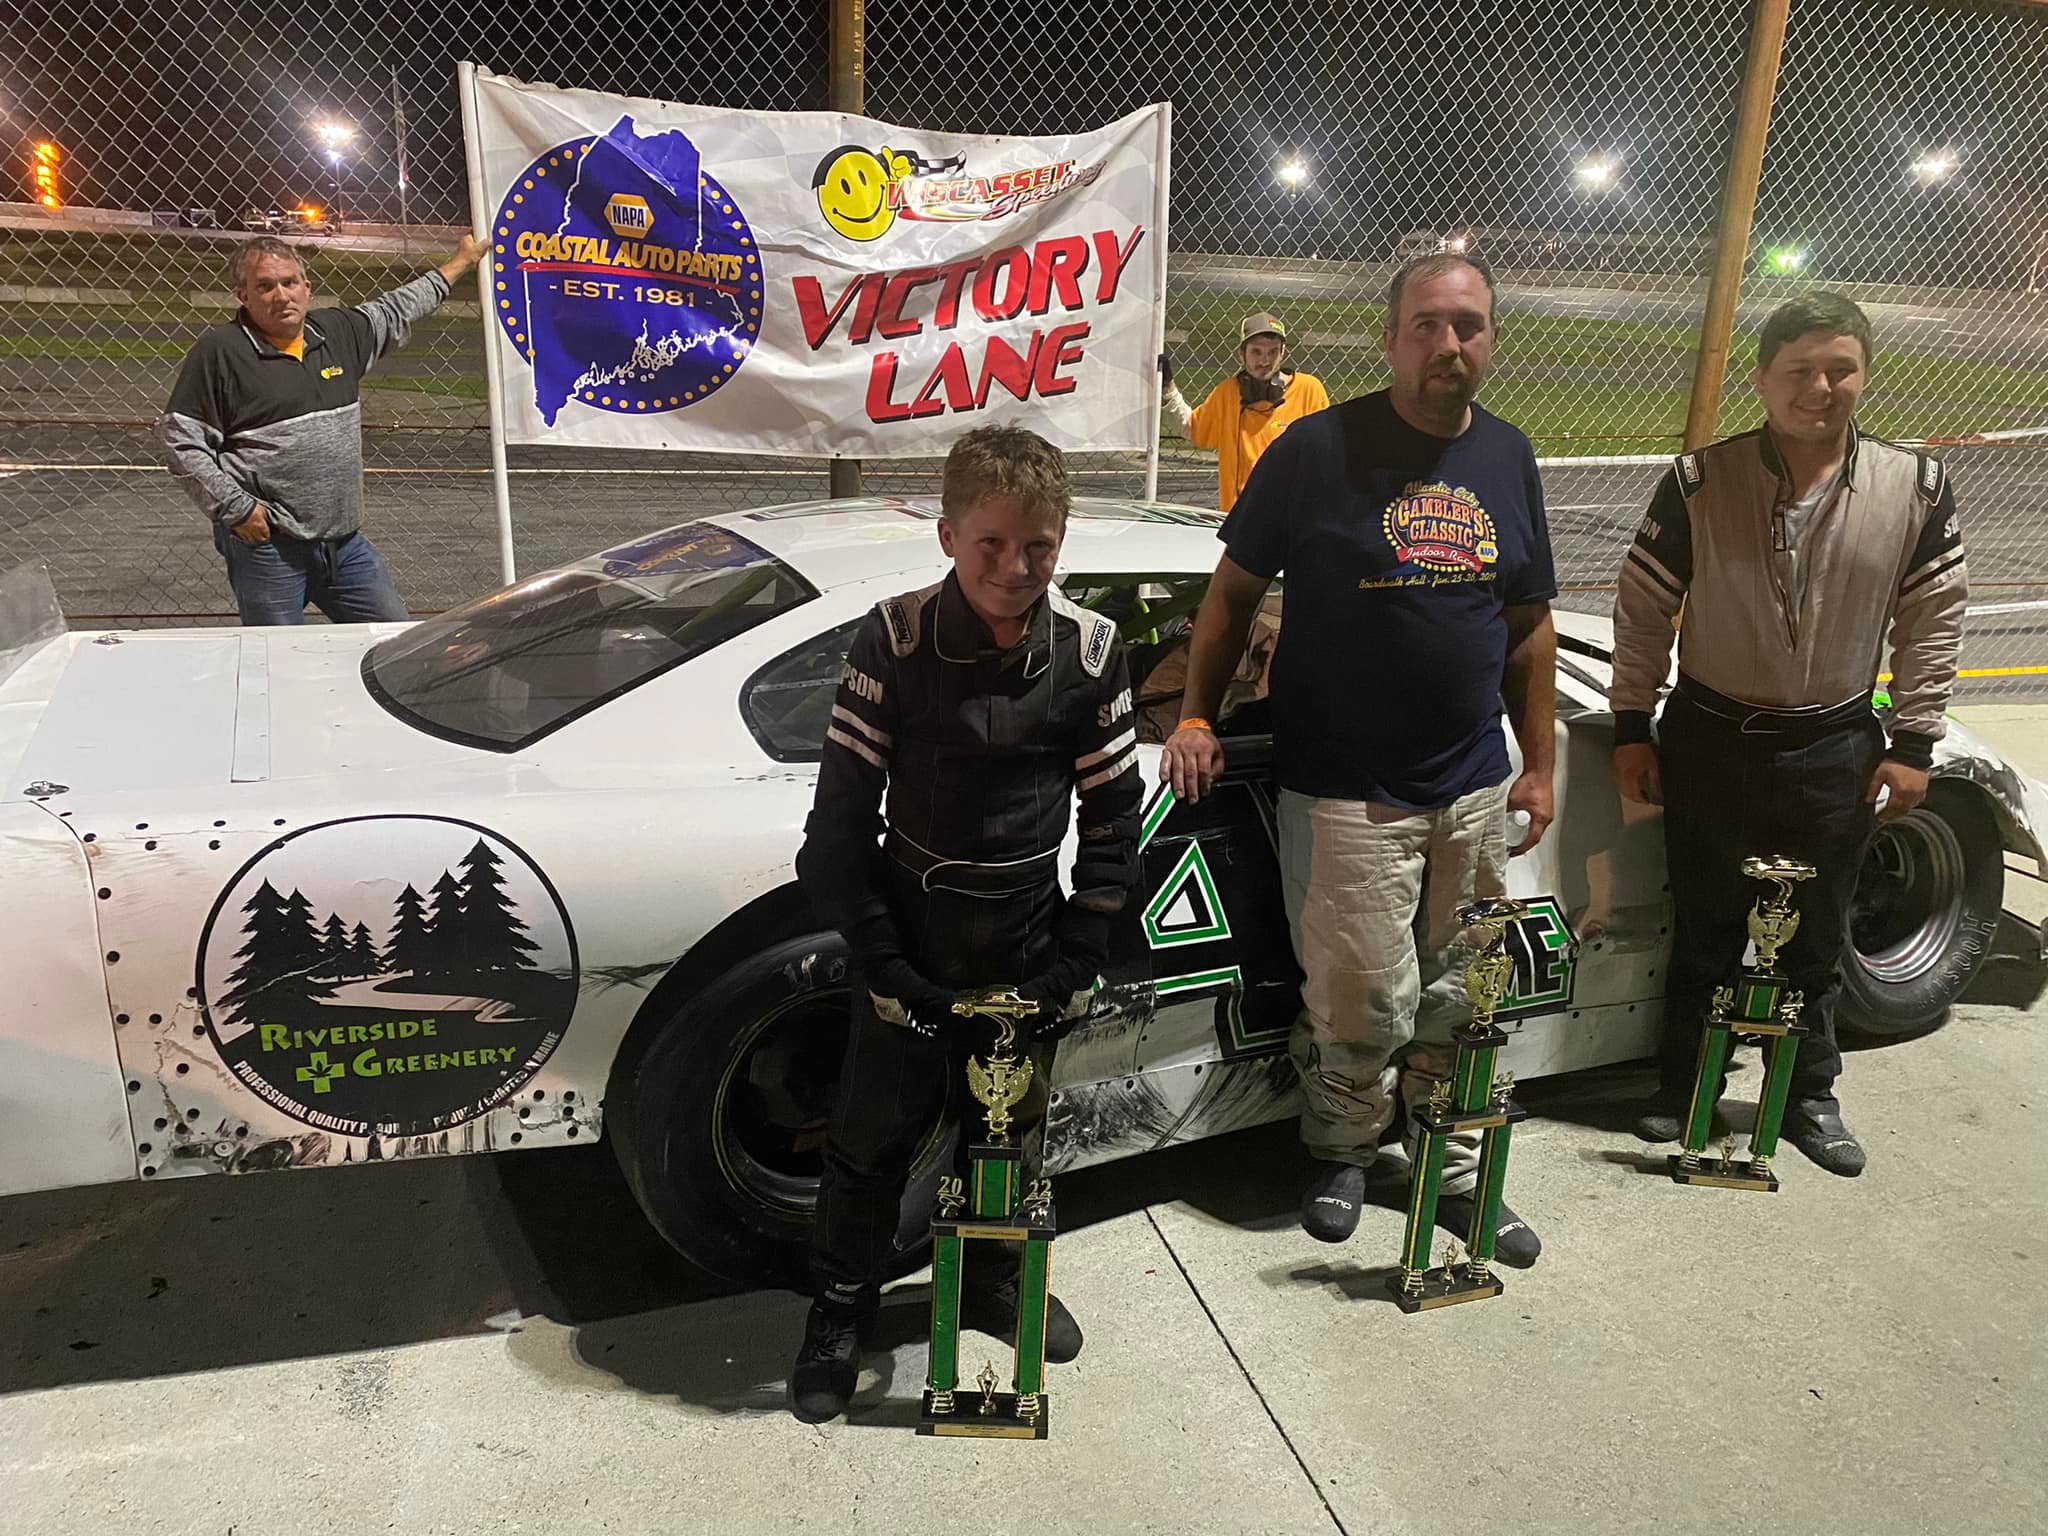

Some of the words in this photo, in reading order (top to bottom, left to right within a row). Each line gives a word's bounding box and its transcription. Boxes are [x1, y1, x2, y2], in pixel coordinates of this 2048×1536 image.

[611, 205, 646, 228] NAPA
[515, 231, 612, 267] COASTAL
[617, 241, 678, 273] AUTO
[676, 252, 743, 281] PARTS
[563, 280, 624, 300] EST.
[634, 287, 695, 308] 1981
[791, 224, 1145, 350] VICTORY
[865, 321, 1091, 424] LANE
[1398, 498, 1485, 537] GAMBLER'S
[1410, 519, 1473, 549] CLASSIC
[1405, 545, 1445, 560] Indoor
[1449, 549, 1476, 569] Race
[1087, 621, 1110, 665] SIMPSON
[232, 1059, 308, 1121] PROFESSIONAL
[307, 1108, 358, 1133] QUALITY
[534, 1030, 561, 1063] MAINE
[938, 1176, 963, 1194] 20
[1029, 1180, 1052, 1199] 22
